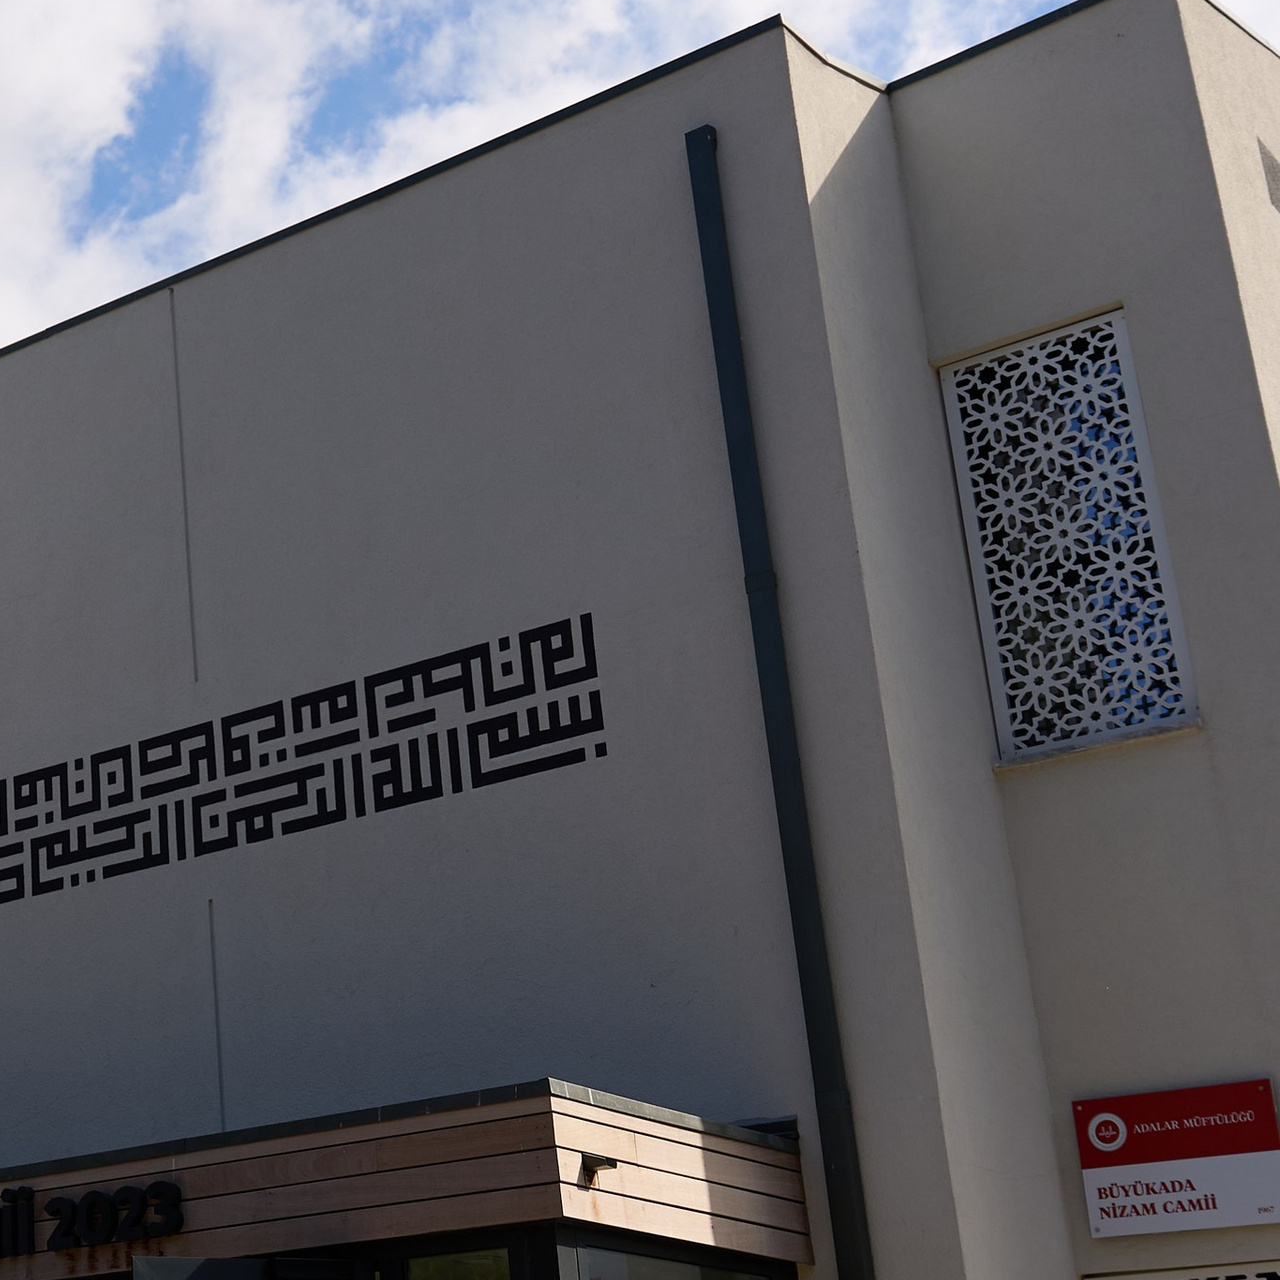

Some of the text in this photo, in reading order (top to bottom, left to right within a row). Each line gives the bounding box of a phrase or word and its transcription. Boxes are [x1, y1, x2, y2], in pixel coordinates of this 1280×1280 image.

[1133, 1110, 1256, 1134] ADALAR MÜFTÜLÜĞÜ
[1096, 1178, 1197, 1200] BÜYÜKADA
[45, 1180, 185, 1251] 2023
[1099, 1193, 1219, 1220] NİZAM CAMİİ
